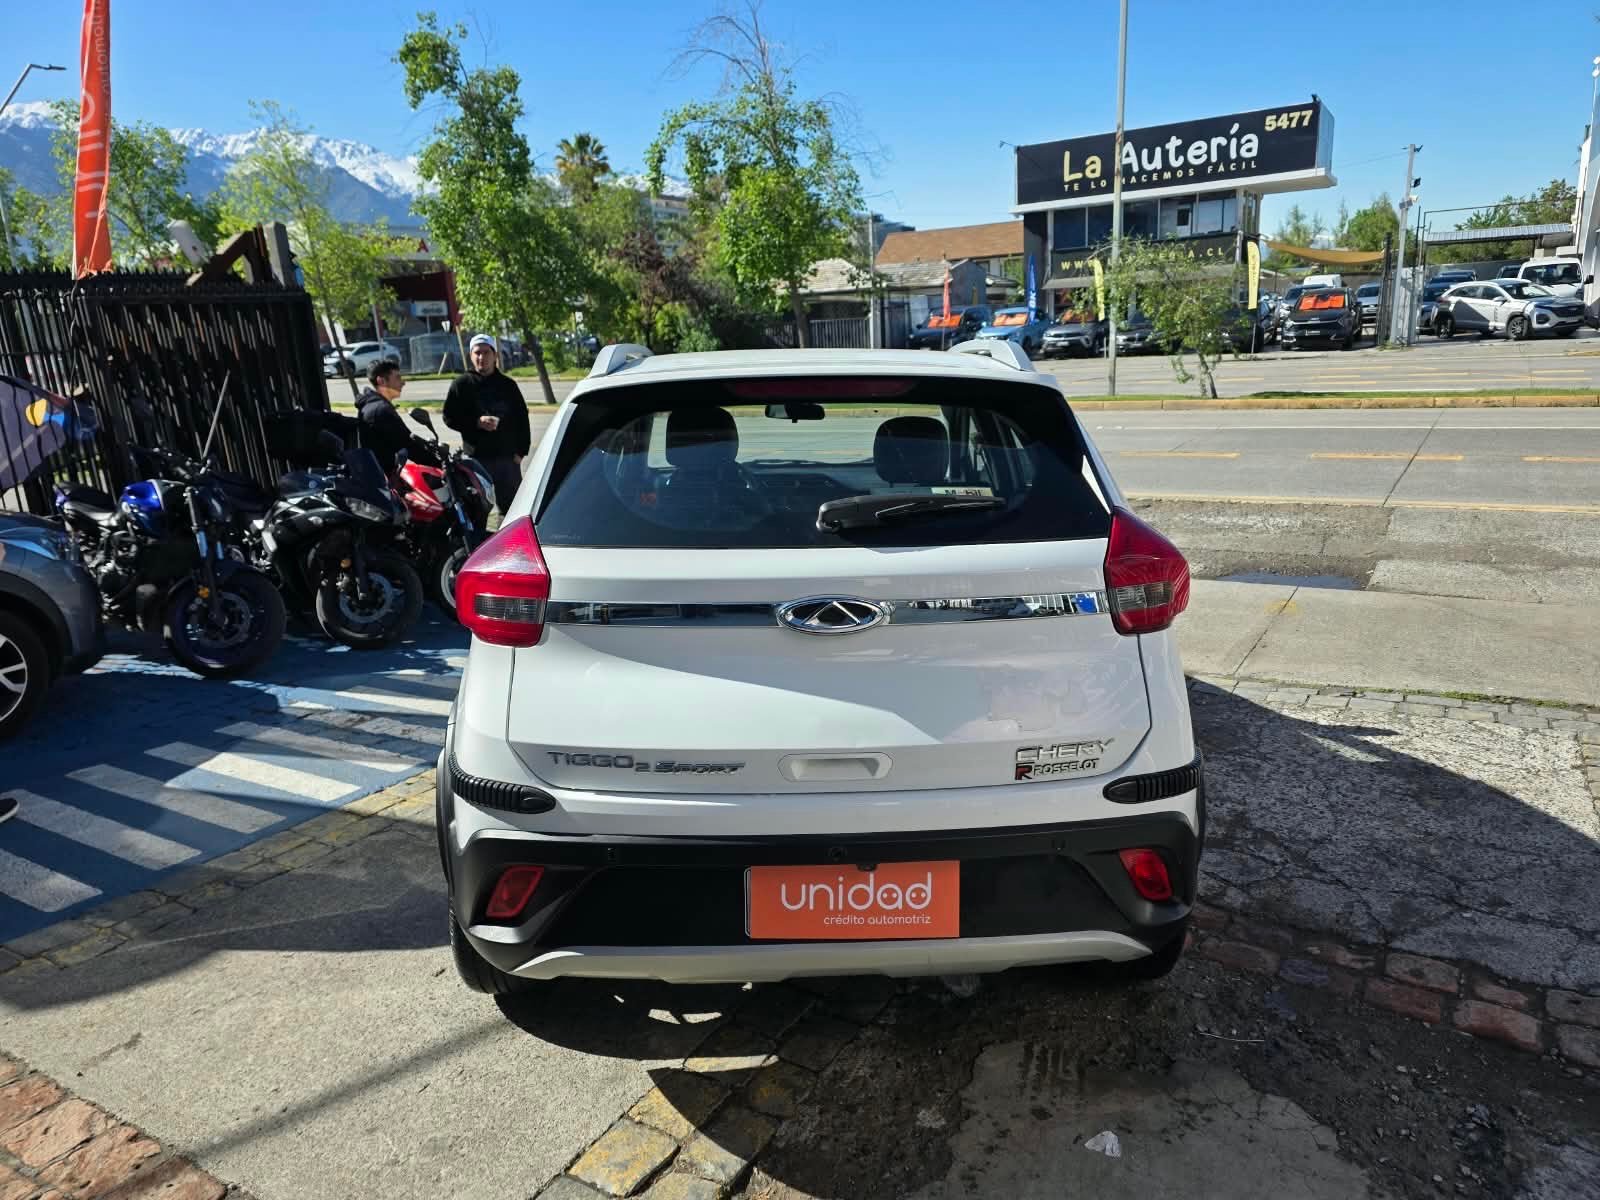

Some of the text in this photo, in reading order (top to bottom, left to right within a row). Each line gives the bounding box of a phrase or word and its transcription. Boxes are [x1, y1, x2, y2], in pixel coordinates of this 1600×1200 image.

[1264, 109, 1313, 132] 5477
[1063, 122, 1259, 183] La Autería
[1064, 184, 1080, 192] TE
[1091, 180, 1107, 189] LO
[1016, 738, 1114, 761] CHERY
[781, 871, 933, 911] unidad
[824, 913, 932, 925] crédito automotriz
